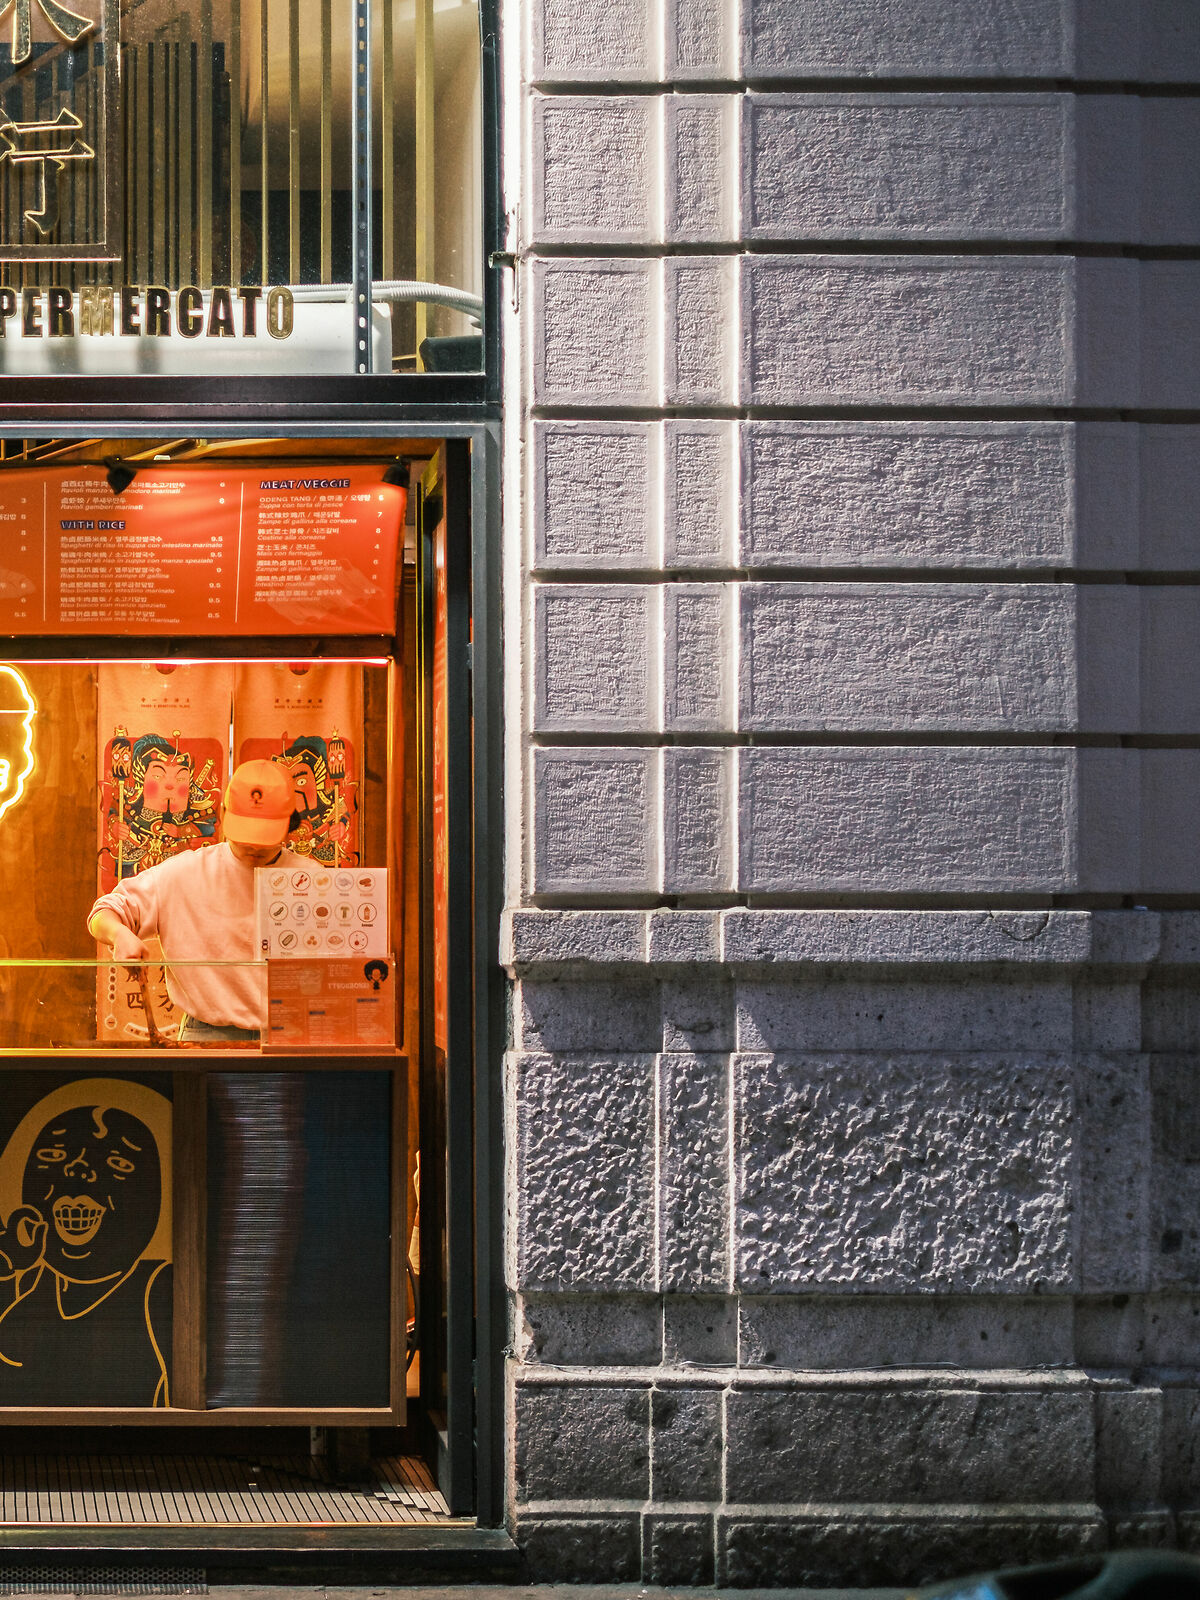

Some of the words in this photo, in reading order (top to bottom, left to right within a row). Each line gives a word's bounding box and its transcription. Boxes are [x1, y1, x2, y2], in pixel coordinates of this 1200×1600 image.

[260, 479, 351, 489] MEAT/VEGGIE
[60, 521, 94, 529] WITH
[98, 521, 126, 529] RICE
